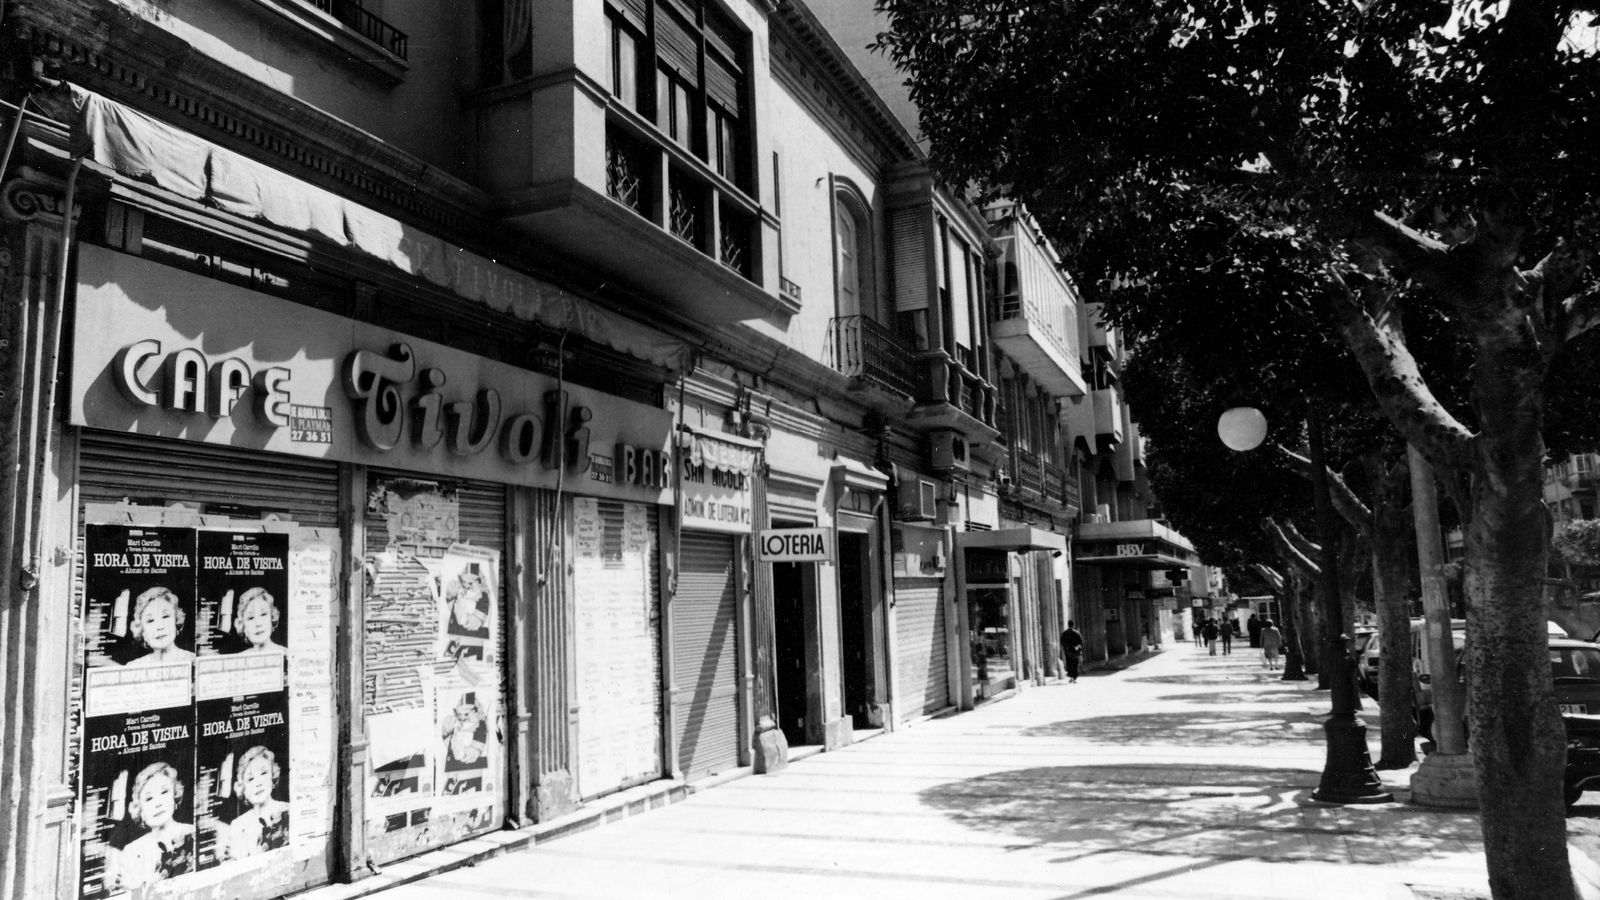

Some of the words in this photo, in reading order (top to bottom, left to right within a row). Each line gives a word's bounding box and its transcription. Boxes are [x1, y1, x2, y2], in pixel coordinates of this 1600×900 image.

[117, 338, 291, 427] CAFE
[346, 342, 592, 475] Tivoli
[619, 443, 671, 489] BAR
[292, 430, 303, 440] 27
[306, 432, 318, 442] 36
[320, 432, 331, 442] 51
[684, 459, 705, 484] SAN
[711, 466, 750, 492] NICOLAS
[708, 502, 716, 521] DE
[761, 534, 825, 555] LOTERIA
[1116, 543, 1145, 557] BBV
[93, 553, 130, 568] HORA
[133, 553, 150, 568] DE
[153, 554, 190, 568] VISITA
[203, 556, 234, 570] HORA
[236, 557, 250, 570] DE
[252, 557, 284, 570] VISITA
[202, 720, 234, 737] HORA
[236, 716, 250, 731] DE
[252, 712, 284, 728] VISITA
[90, 734, 128, 753] HORA
[131, 730, 149, 746] DE
[152, 724, 190, 743] VISITA
